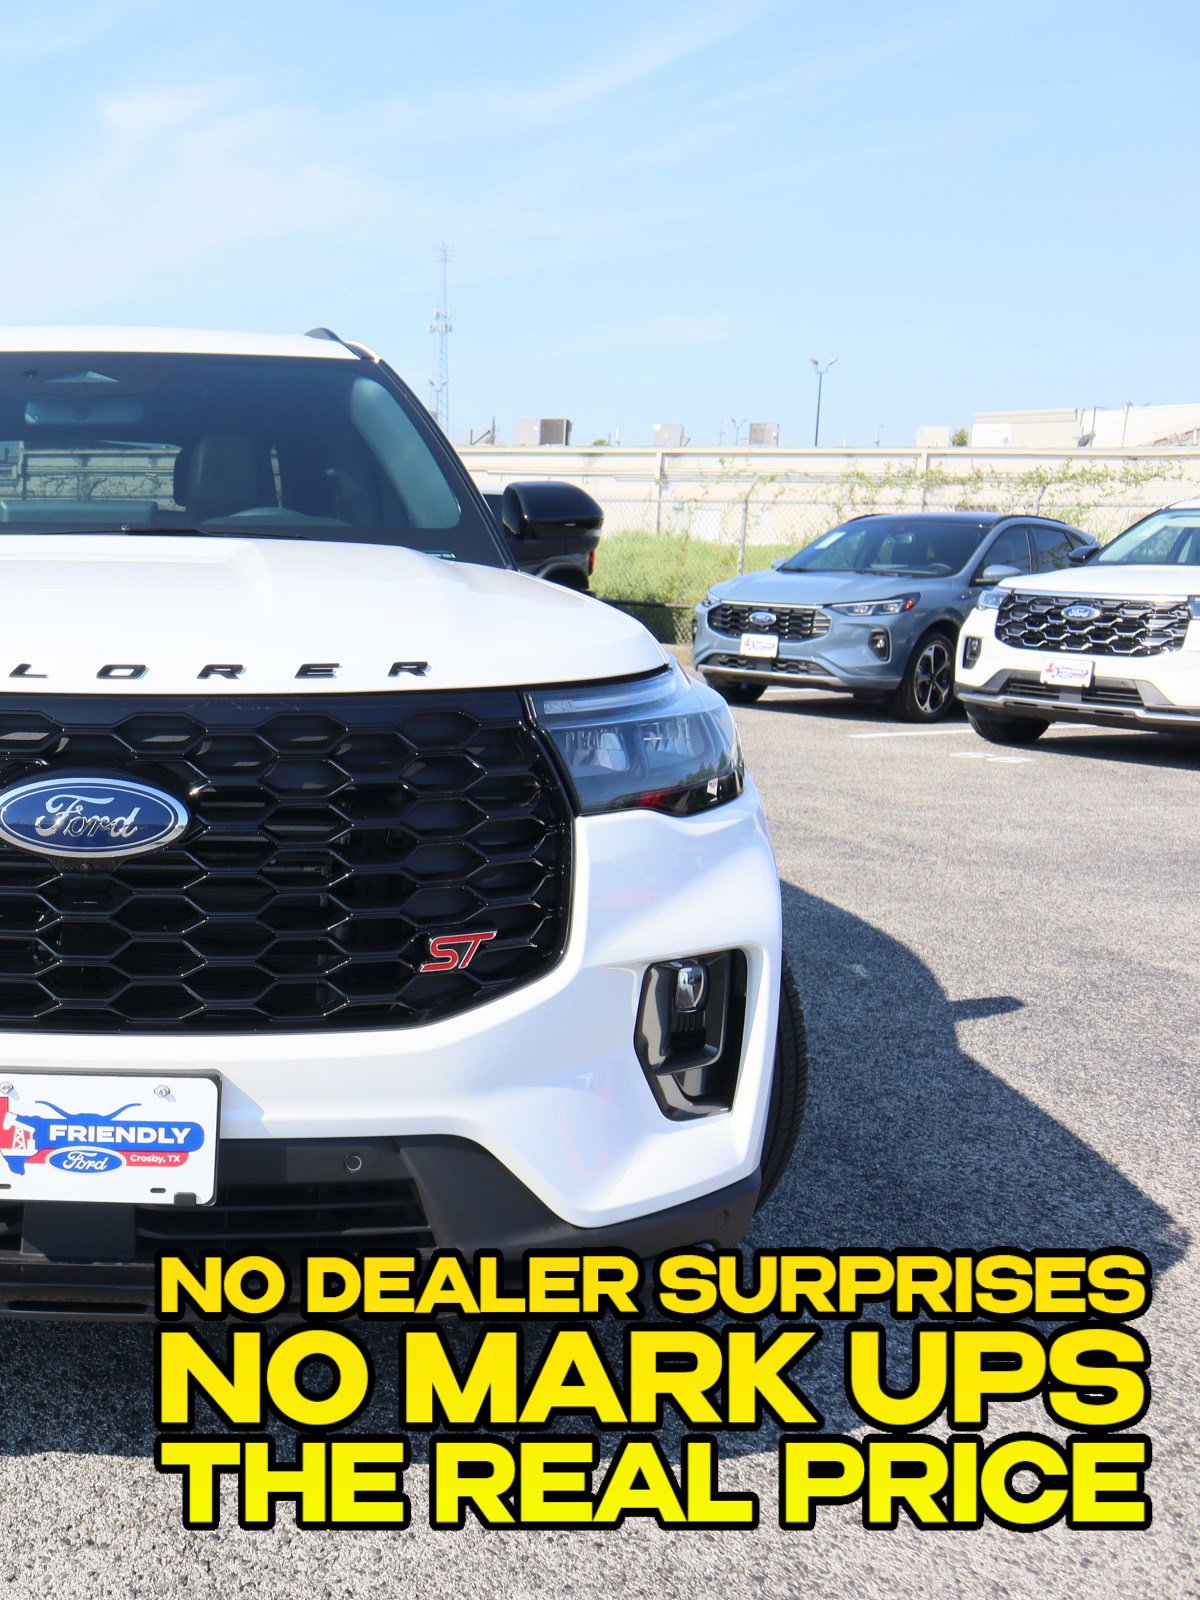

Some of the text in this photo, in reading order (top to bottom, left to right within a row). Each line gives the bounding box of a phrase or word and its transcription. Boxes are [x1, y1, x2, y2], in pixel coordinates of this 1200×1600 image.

[34, 794, 141, 838] Ford
[420, 931, 498, 972] ST
[50, 1125, 191, 1144] FRIENDLY
[62, 1150, 108, 1171] Ford
[130, 1153, 181, 1164] Crosby, TX
